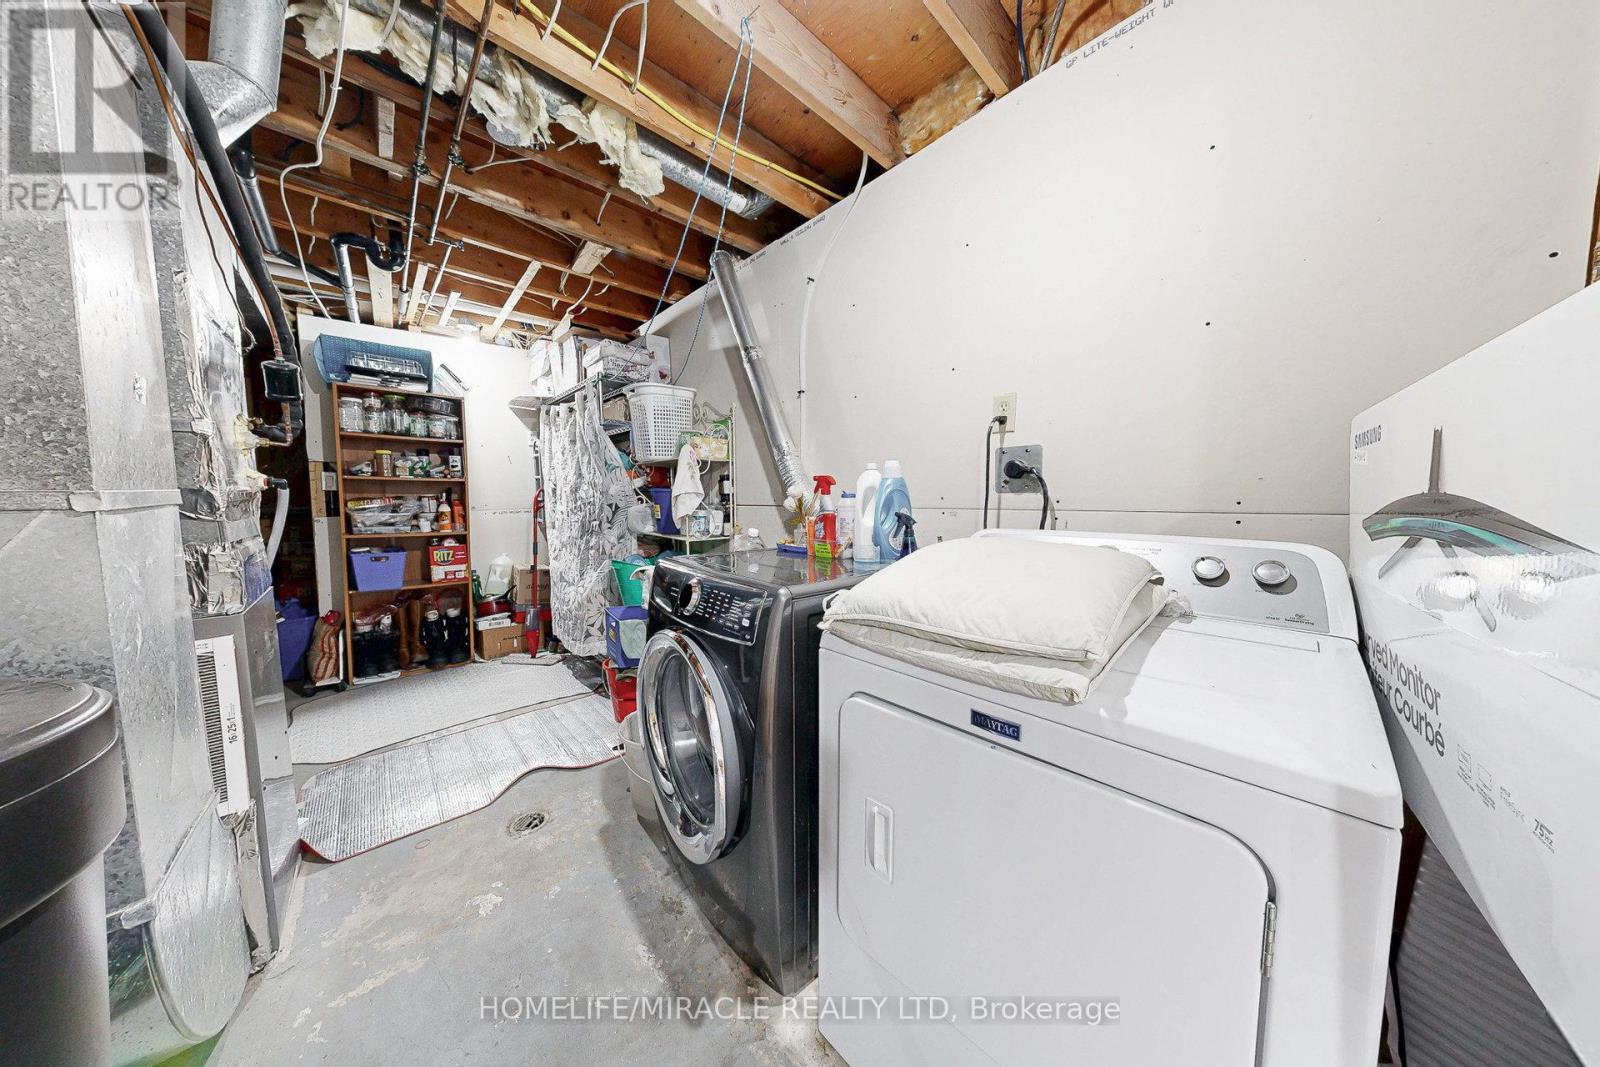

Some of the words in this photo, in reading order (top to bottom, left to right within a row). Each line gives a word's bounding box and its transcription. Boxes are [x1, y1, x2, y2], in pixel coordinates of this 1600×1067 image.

[1083, 7, 1157, 58] LITE-WEIGHT
[1354, 424, 1382, 450] SAMSUNG
[433, 550, 455, 562] RITZ
[1389, 647, 1441, 716] Monitor
[1394, 687, 1445, 757] Courbé
